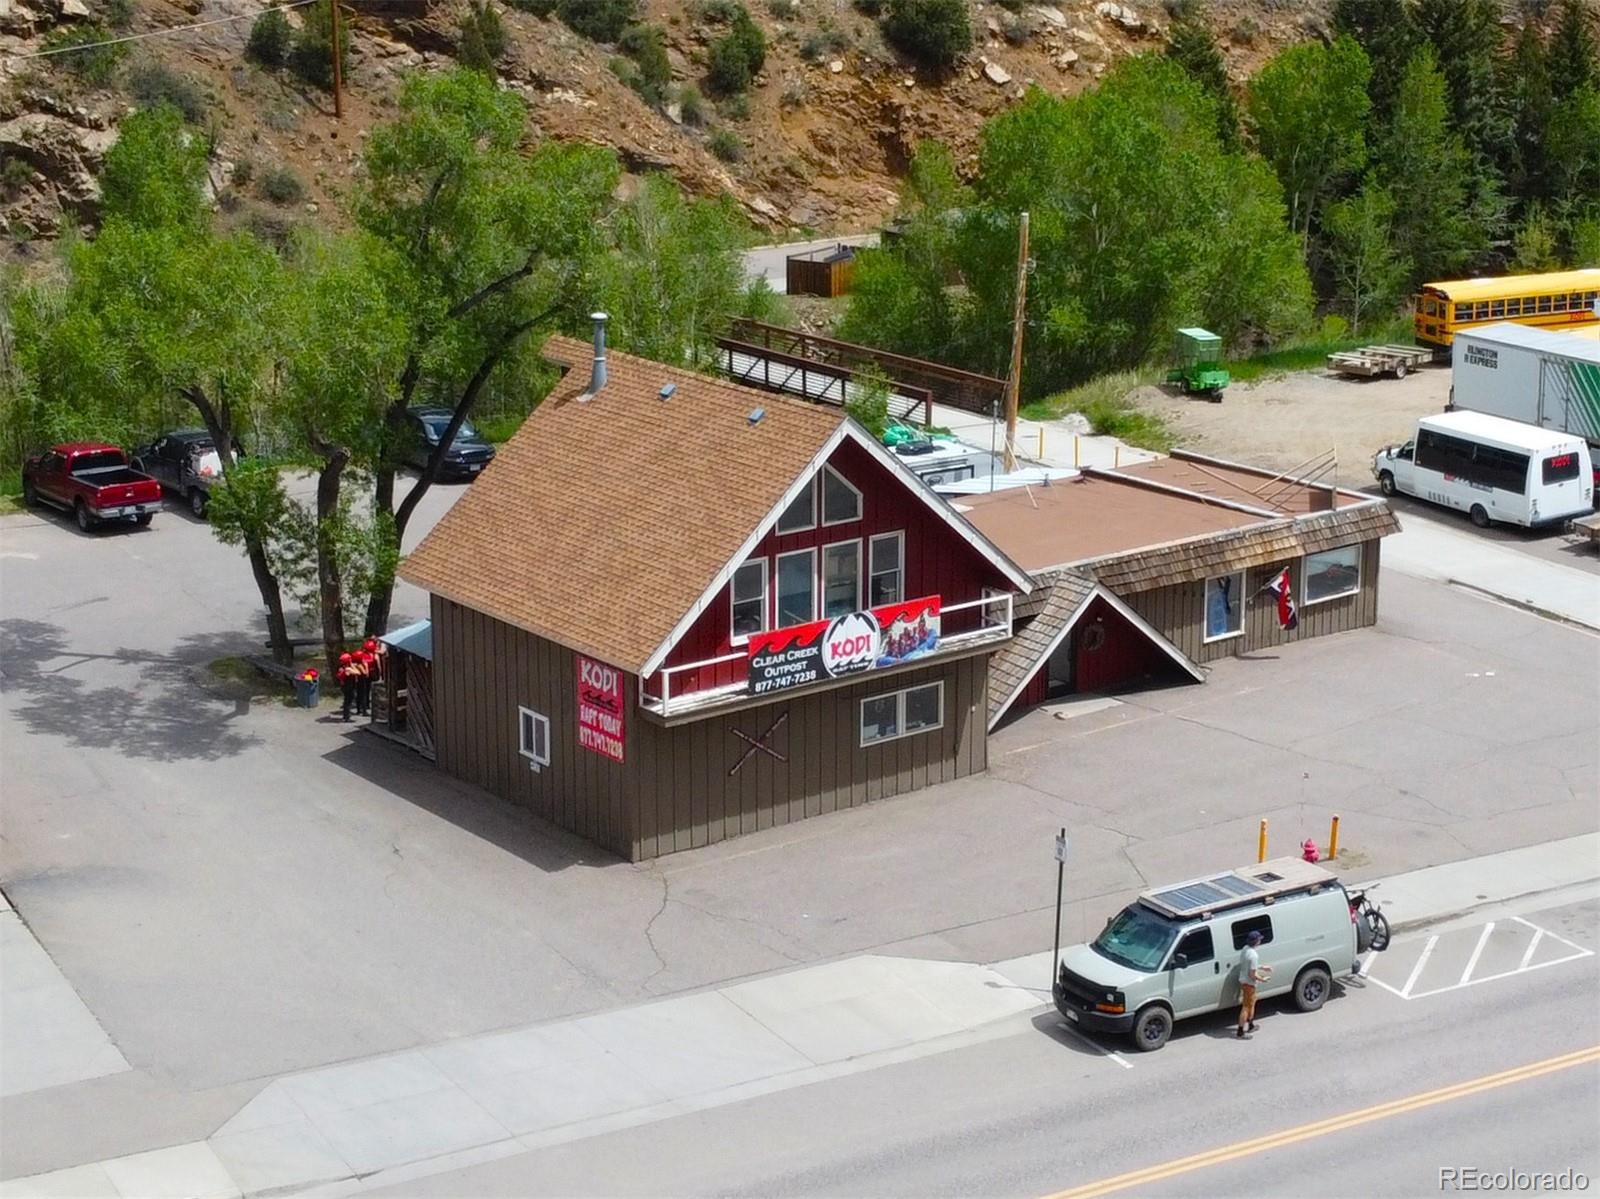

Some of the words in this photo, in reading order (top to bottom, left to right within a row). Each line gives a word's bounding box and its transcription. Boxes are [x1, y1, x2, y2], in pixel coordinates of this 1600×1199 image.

[753, 654, 785, 668] CLEAR
[787, 646, 818, 661] CREEK
[831, 634, 871, 660] KODI
[581, 660, 617, 697] KODI
[755, 669, 817, 692] 877-747-7238
[764, 661, 808, 678] OUTPOST
